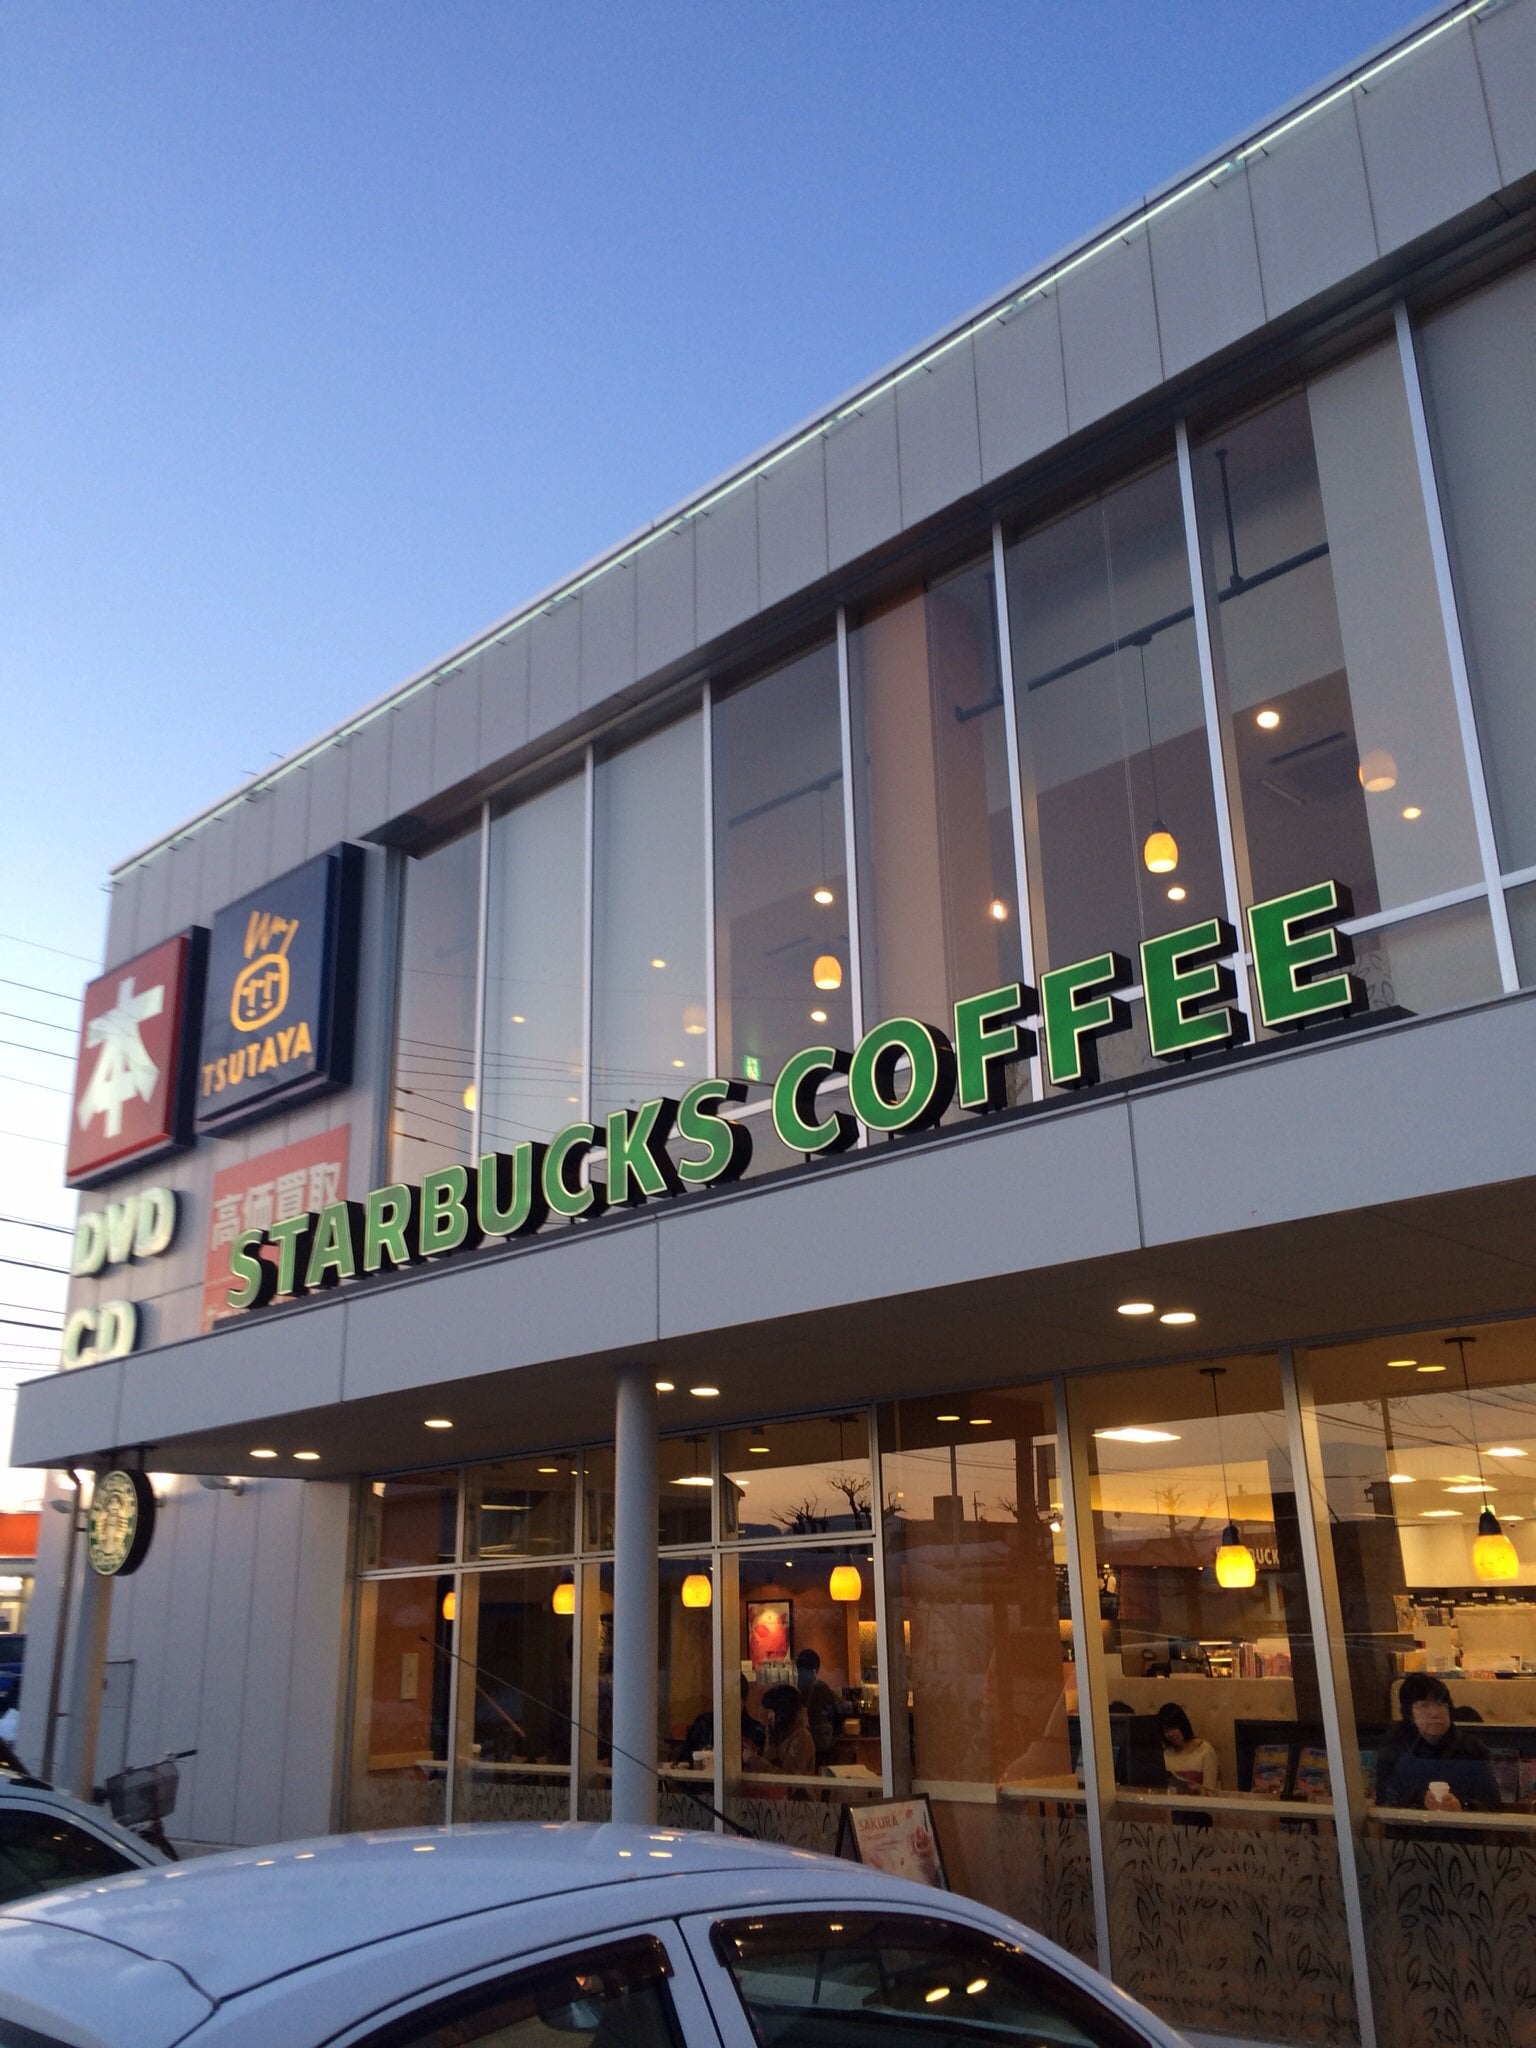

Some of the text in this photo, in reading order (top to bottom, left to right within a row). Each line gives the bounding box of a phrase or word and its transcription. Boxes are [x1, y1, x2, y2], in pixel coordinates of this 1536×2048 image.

[76, 976, 165, 1139] 本
[202, 1021, 313, 1097] TSUTAYA
[226, 878, 1353, 1309] STARBUCKS COFFEE
[70, 1186, 177, 1278] DVD
[211, 1162, 342, 1251] 高価買取
[61, 1299, 137, 1371] CD
[858, 1814, 900, 1832] SAKURA
